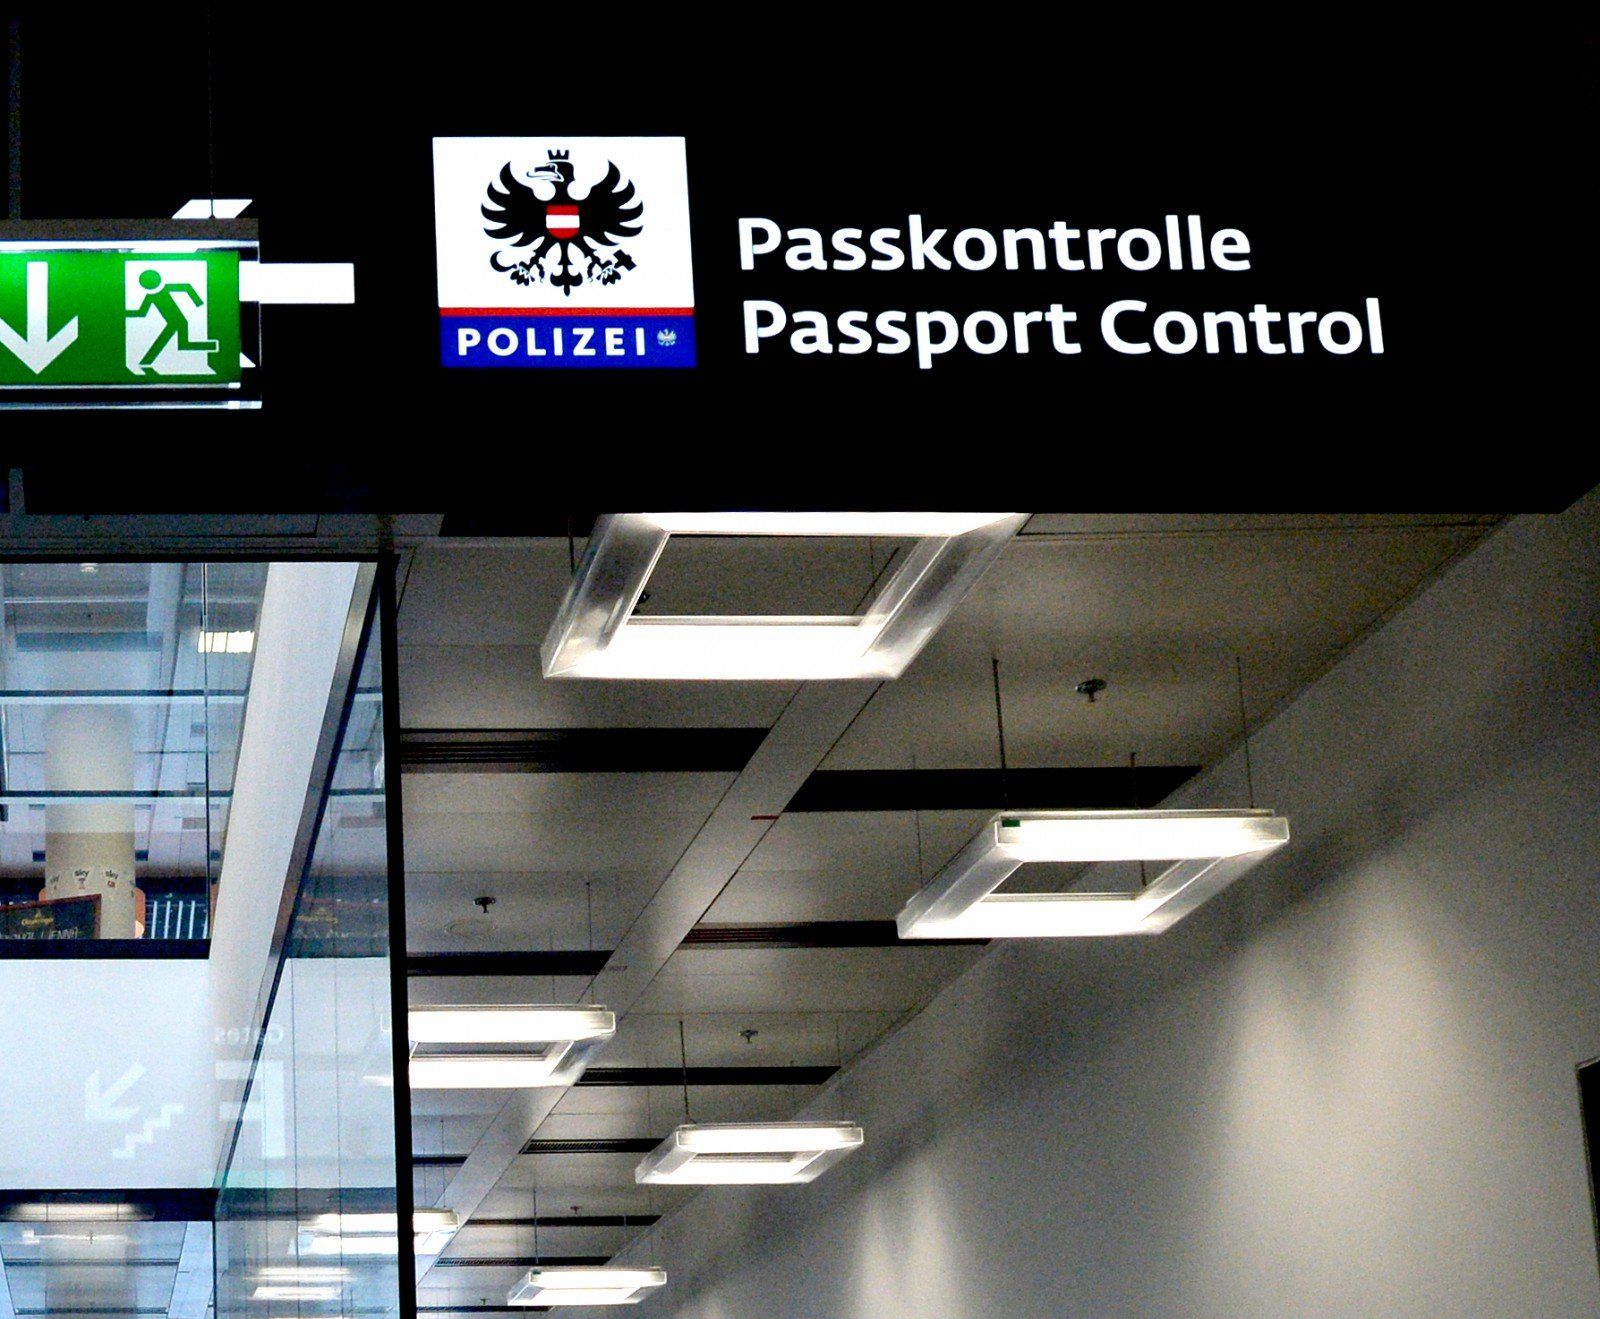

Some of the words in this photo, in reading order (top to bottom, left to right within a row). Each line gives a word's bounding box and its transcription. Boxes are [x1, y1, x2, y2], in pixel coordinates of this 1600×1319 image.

[738, 214, 1251, 272] Passkontrolle
[457, 327, 646, 357] POLIZEI
[742, 299, 1082, 370] Passport
[1100, 297, 1385, 355] Control
